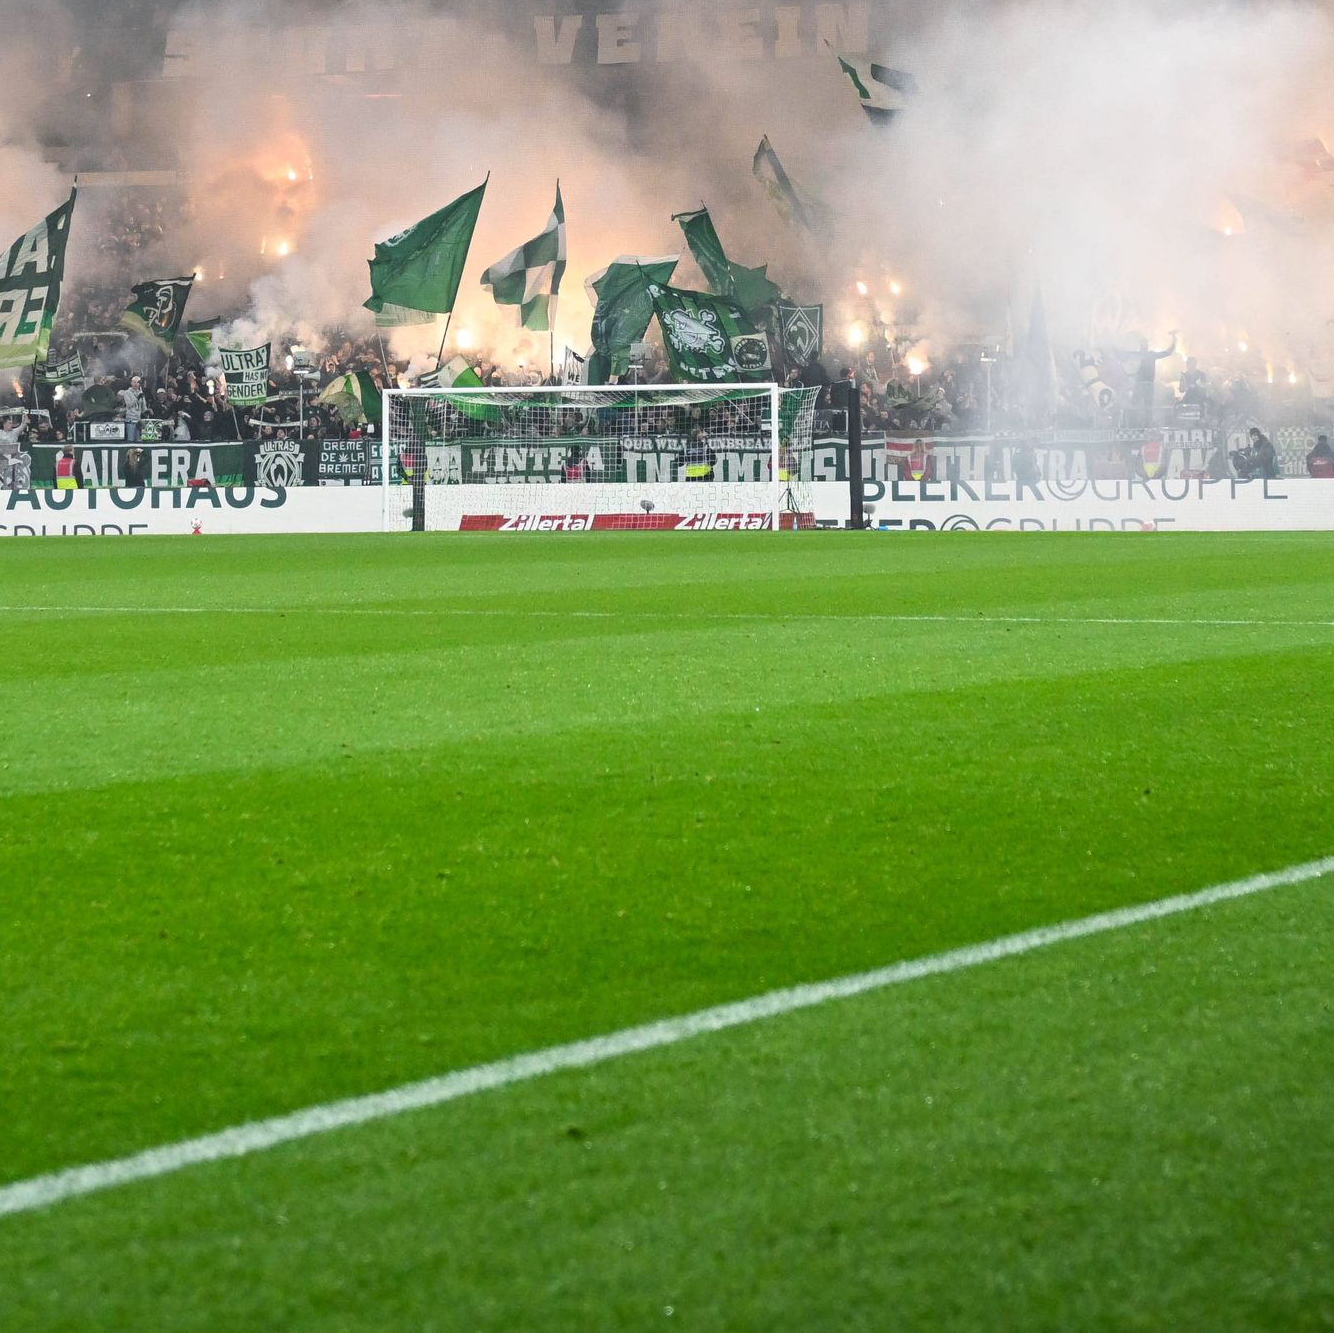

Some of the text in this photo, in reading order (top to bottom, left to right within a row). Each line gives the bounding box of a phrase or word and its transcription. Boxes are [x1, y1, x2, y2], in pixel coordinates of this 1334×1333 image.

[264, 441, 296, 453] ULTRAS
[321, 452, 365, 462] DE LA
[471, 446, 605, 472] L'INTEA
[55, 448, 216, 487] AILERA
[318, 463, 366, 474] BREMEN
[499, 513, 773, 531] Zillertal Zillertal
